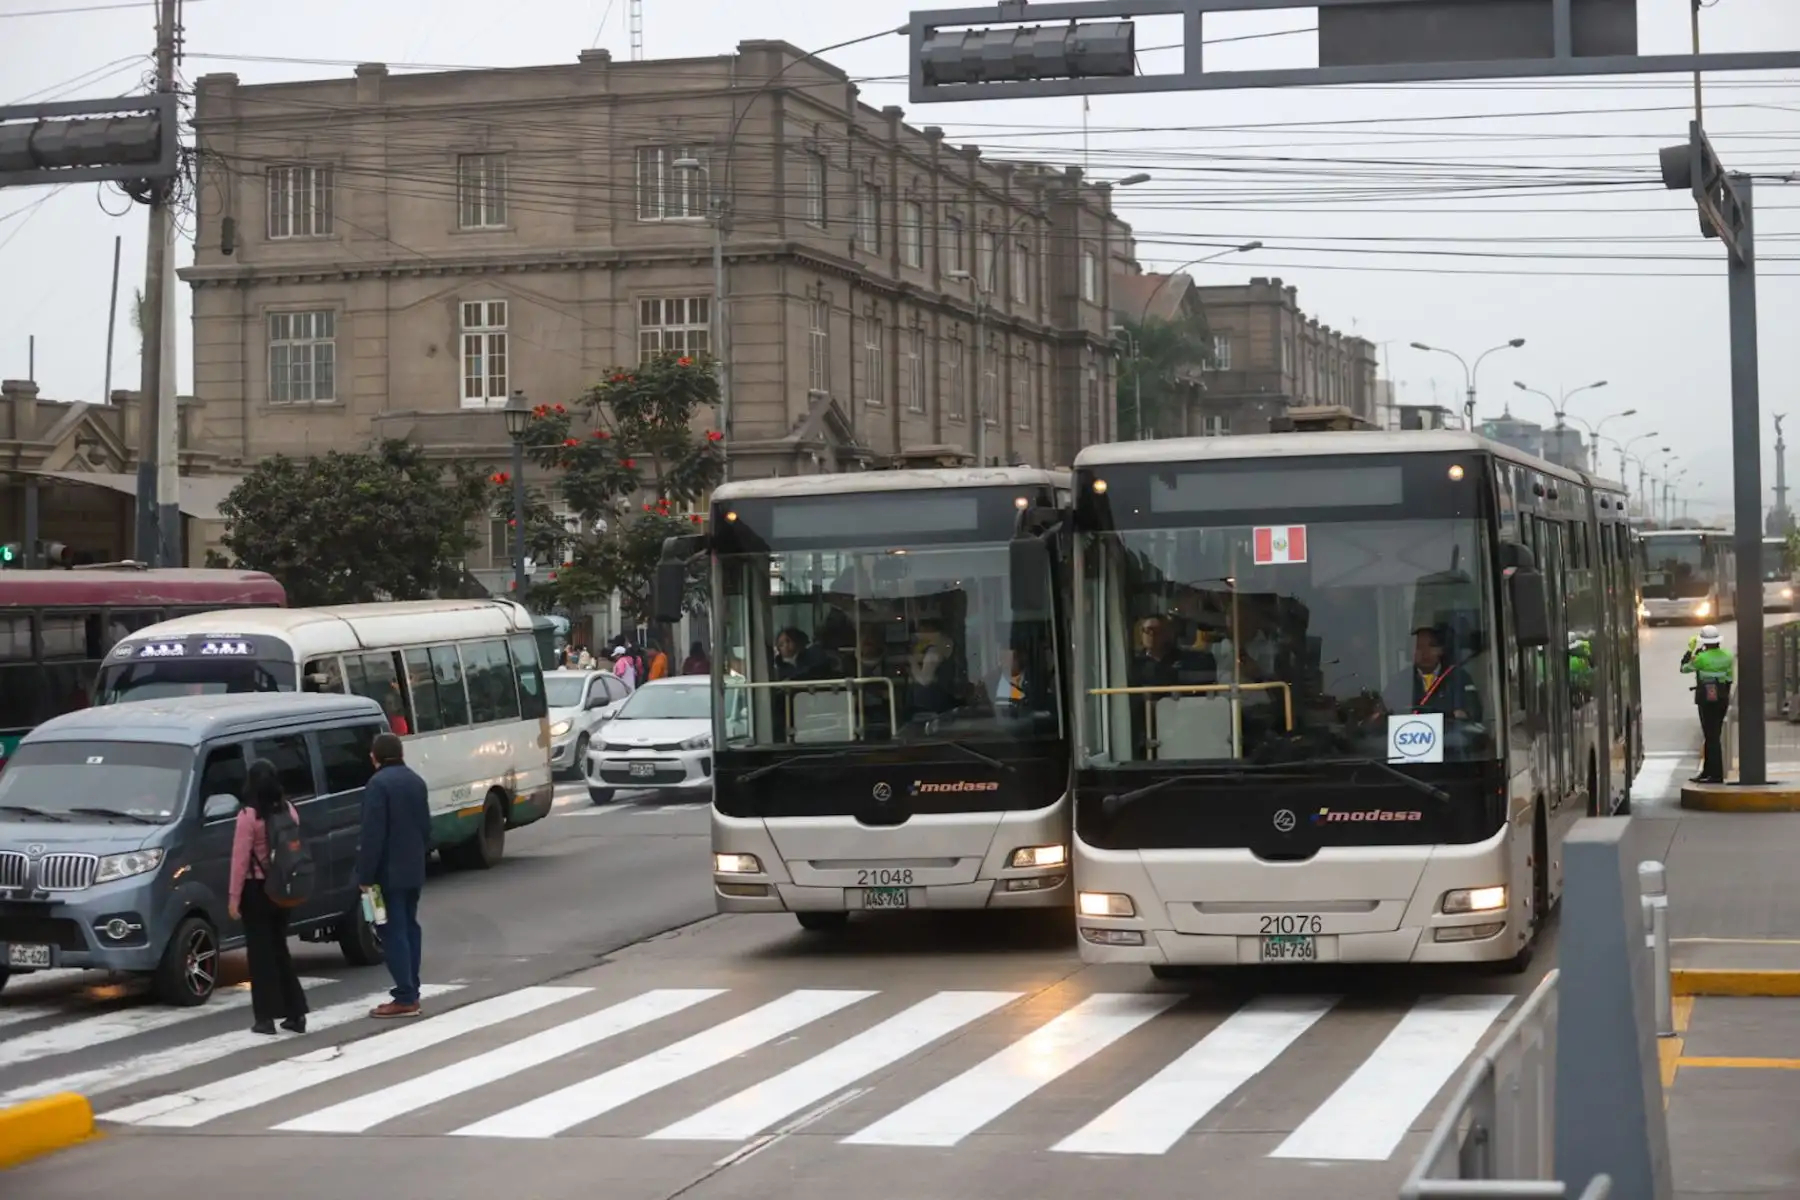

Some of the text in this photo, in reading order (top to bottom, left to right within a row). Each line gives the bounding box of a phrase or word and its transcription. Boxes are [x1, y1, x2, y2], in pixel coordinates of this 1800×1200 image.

[1398, 732, 1432, 745] SXN
[920, 781, 998, 792] modasa
[1326, 809, 1423, 821] modasa
[857, 869, 914, 885] 21048
[1259, 915, 1322, 934] 21076
